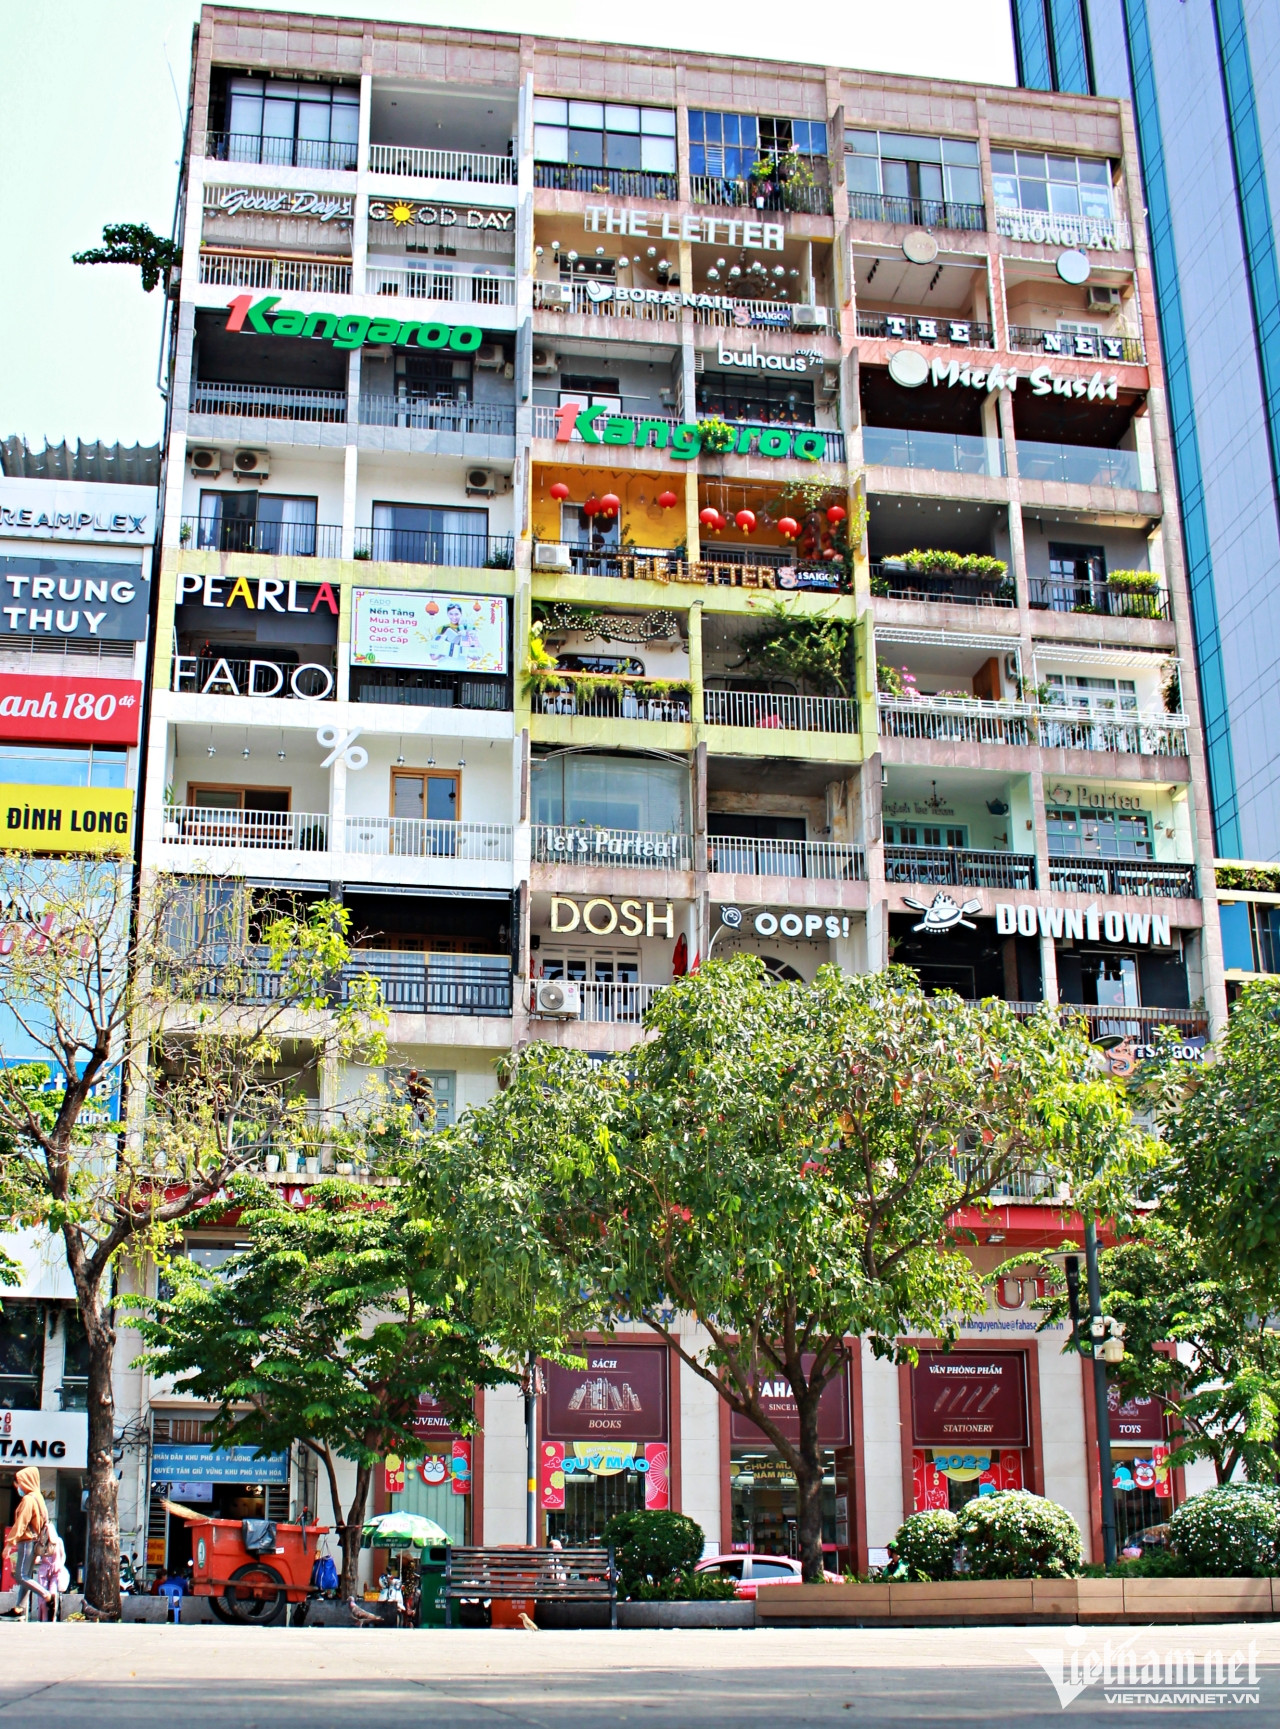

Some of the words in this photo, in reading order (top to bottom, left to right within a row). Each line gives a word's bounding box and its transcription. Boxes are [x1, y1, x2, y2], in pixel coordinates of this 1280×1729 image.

[220, 189, 288, 216] Good
[291, 192, 350, 222] Days
[467, 209, 512, 231] DAY
[586, 205, 648, 237] THE
[662, 212, 784, 250] LETTER
[615, 286, 676, 305] BORA
[682, 293, 733, 310] NAIL
[756, 311, 790, 321] SAIGON
[887, 316, 969, 342] THE
[1044, 333, 1122, 358] NEY
[931, 357, 1017, 393] Michi
[1029, 365, 1118, 401] Sushi
[677, 559, 776, 590] LETTER
[6, 575, 136, 605] TRUNG
[175, 574, 339, 615] PEARLA
[3, 607, 107, 634] THUY
[393, 617, 418, 627] Hàng
[172, 655, 334, 701] FADO
[62, 692, 116, 720] 180
[119, 695, 135, 707] độ
[1077, 785, 1143, 811] Partea
[7, 804, 61, 831] ĐÌNH
[71, 809, 128, 833] LONG
[551, 896, 674, 939] DOSH
[755, 911, 849, 939] OOPS!
[592, 1357, 617, 1369] SÁCH
[929, 1364, 946, 1375] VĂN
[947, 1364, 976, 1375] PHÒNG
[769, 1403, 791, 1411] SINCE
[589, 1419, 622, 1430] BOOKS
[943, 1424, 994, 1433] STATIONERY
[1119, 1424, 1141, 1434] TOYS
[200, 1452, 213, 1461] PHỐ
[935, 1454, 990, 1471] 2023
[176, 1466, 190, 1474] TÂM
[240, 1466, 253, 1475] PHỐ
[155, 1485, 166, 1493] 42
